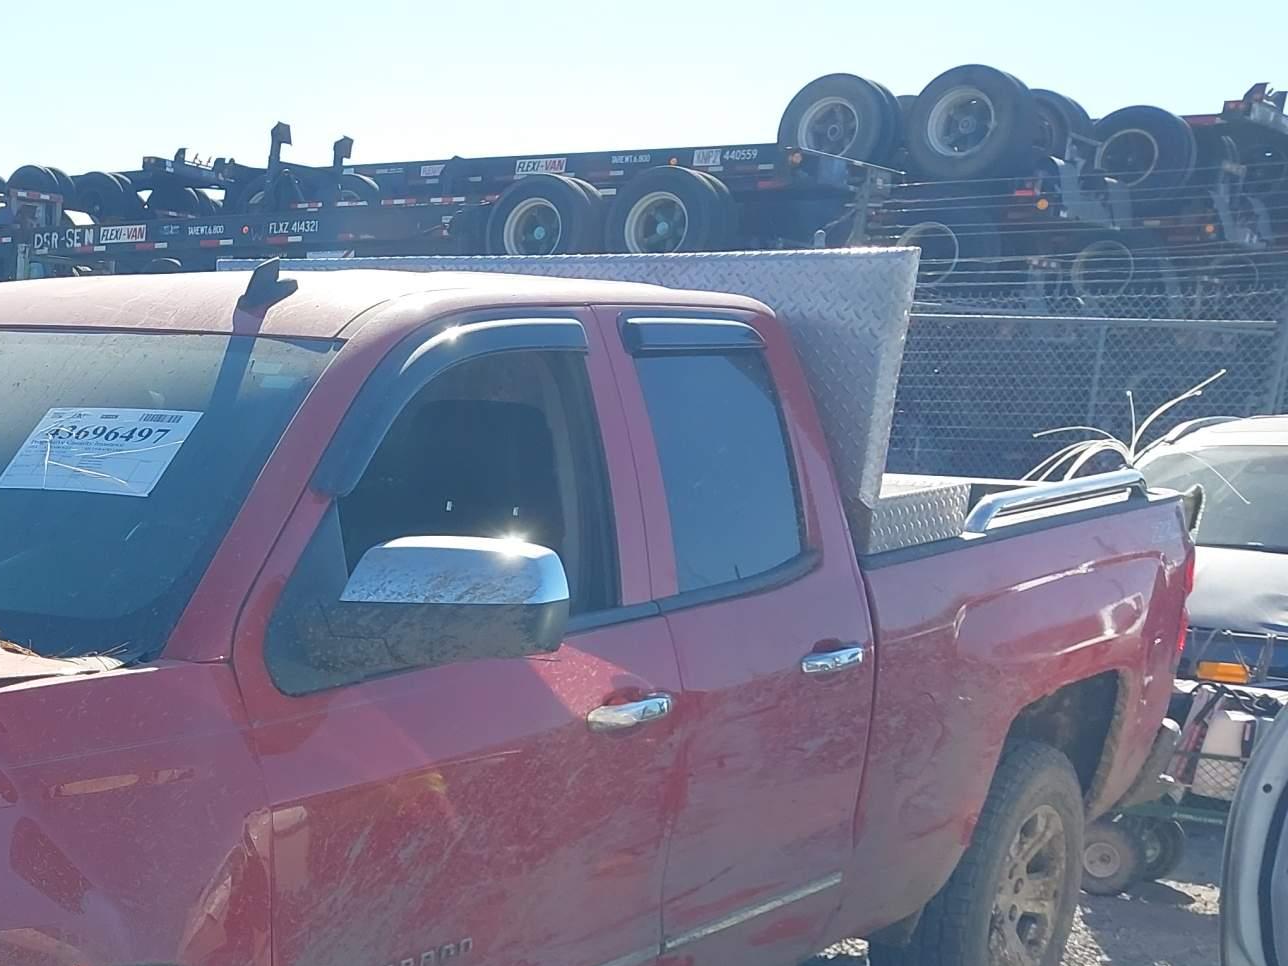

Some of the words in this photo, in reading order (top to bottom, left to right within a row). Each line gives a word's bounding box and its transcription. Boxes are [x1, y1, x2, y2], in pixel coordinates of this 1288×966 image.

[723, 149, 758, 161] 440559
[518, 160, 564, 172] FLEXI-VAN
[102, 226, 145, 241] FLEXI-VAN
[269, 223, 289, 234] FLXZ
[291, 220, 319, 232] 414321
[45, 424, 172, 444] 43696497
